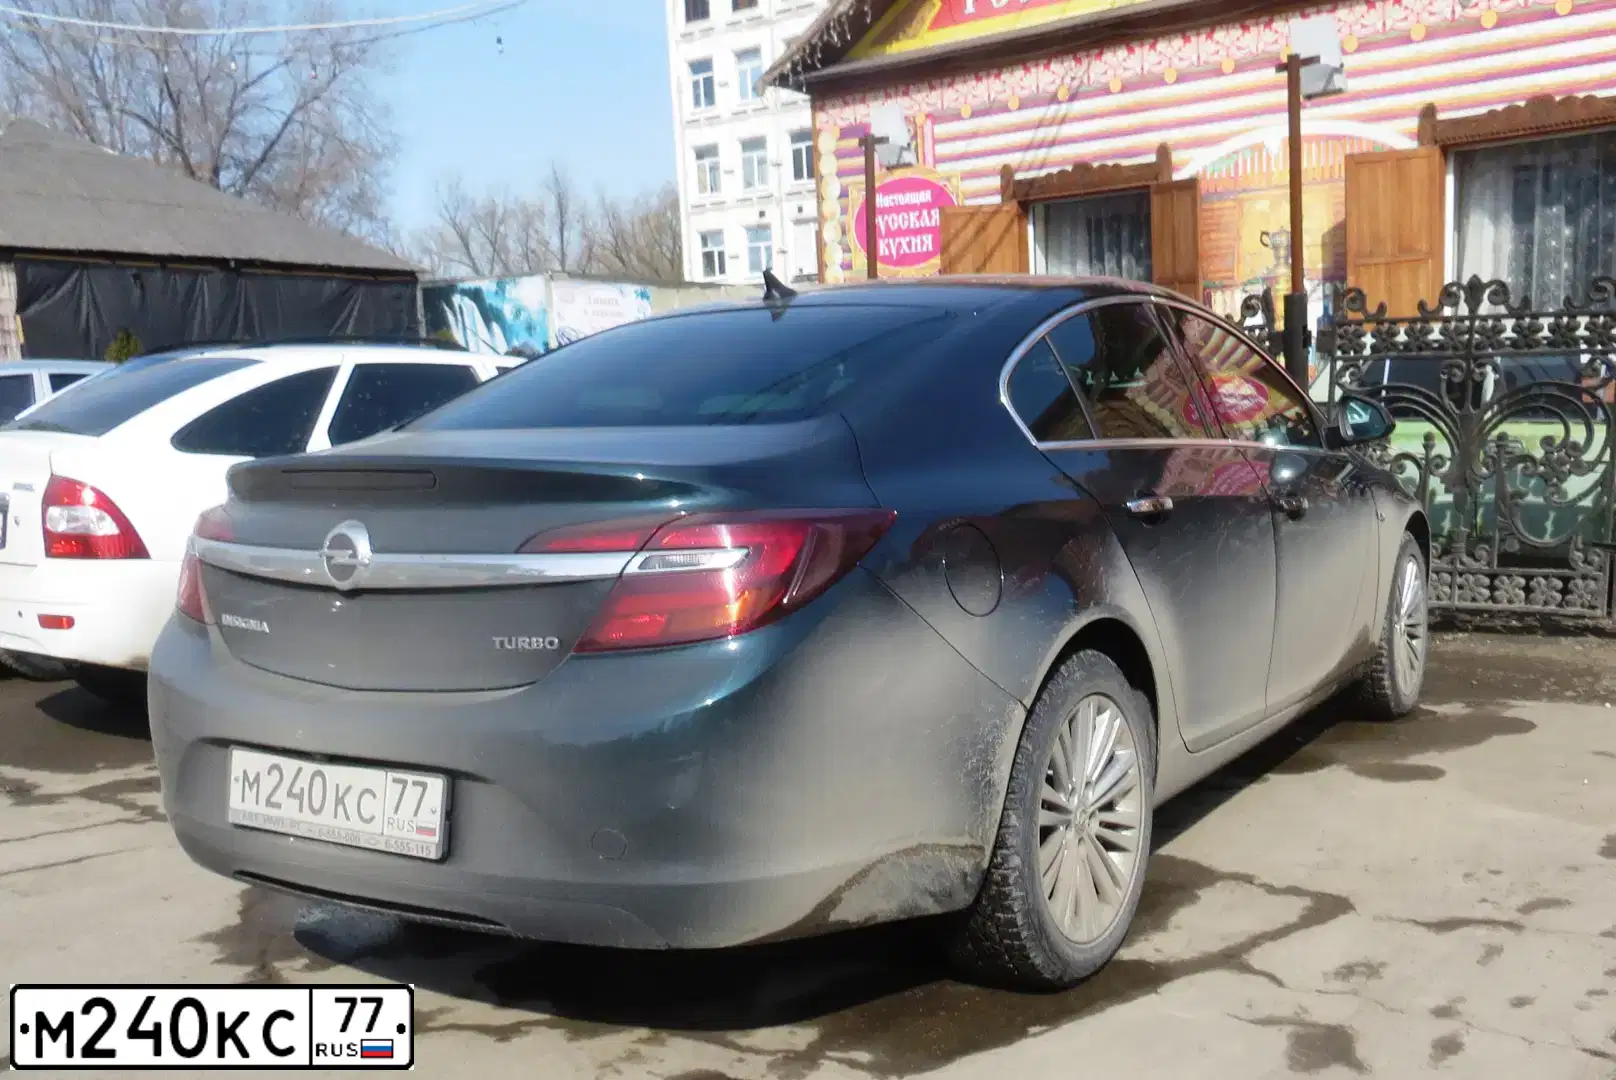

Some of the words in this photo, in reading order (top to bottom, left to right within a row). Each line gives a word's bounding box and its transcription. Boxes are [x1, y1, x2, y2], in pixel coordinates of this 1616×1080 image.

[876, 208, 940, 236] УССКАЯ
[492, 636, 559, 649] TURBO
[392, 777, 428, 817] 77
[387, 816, 415, 833] RUS
